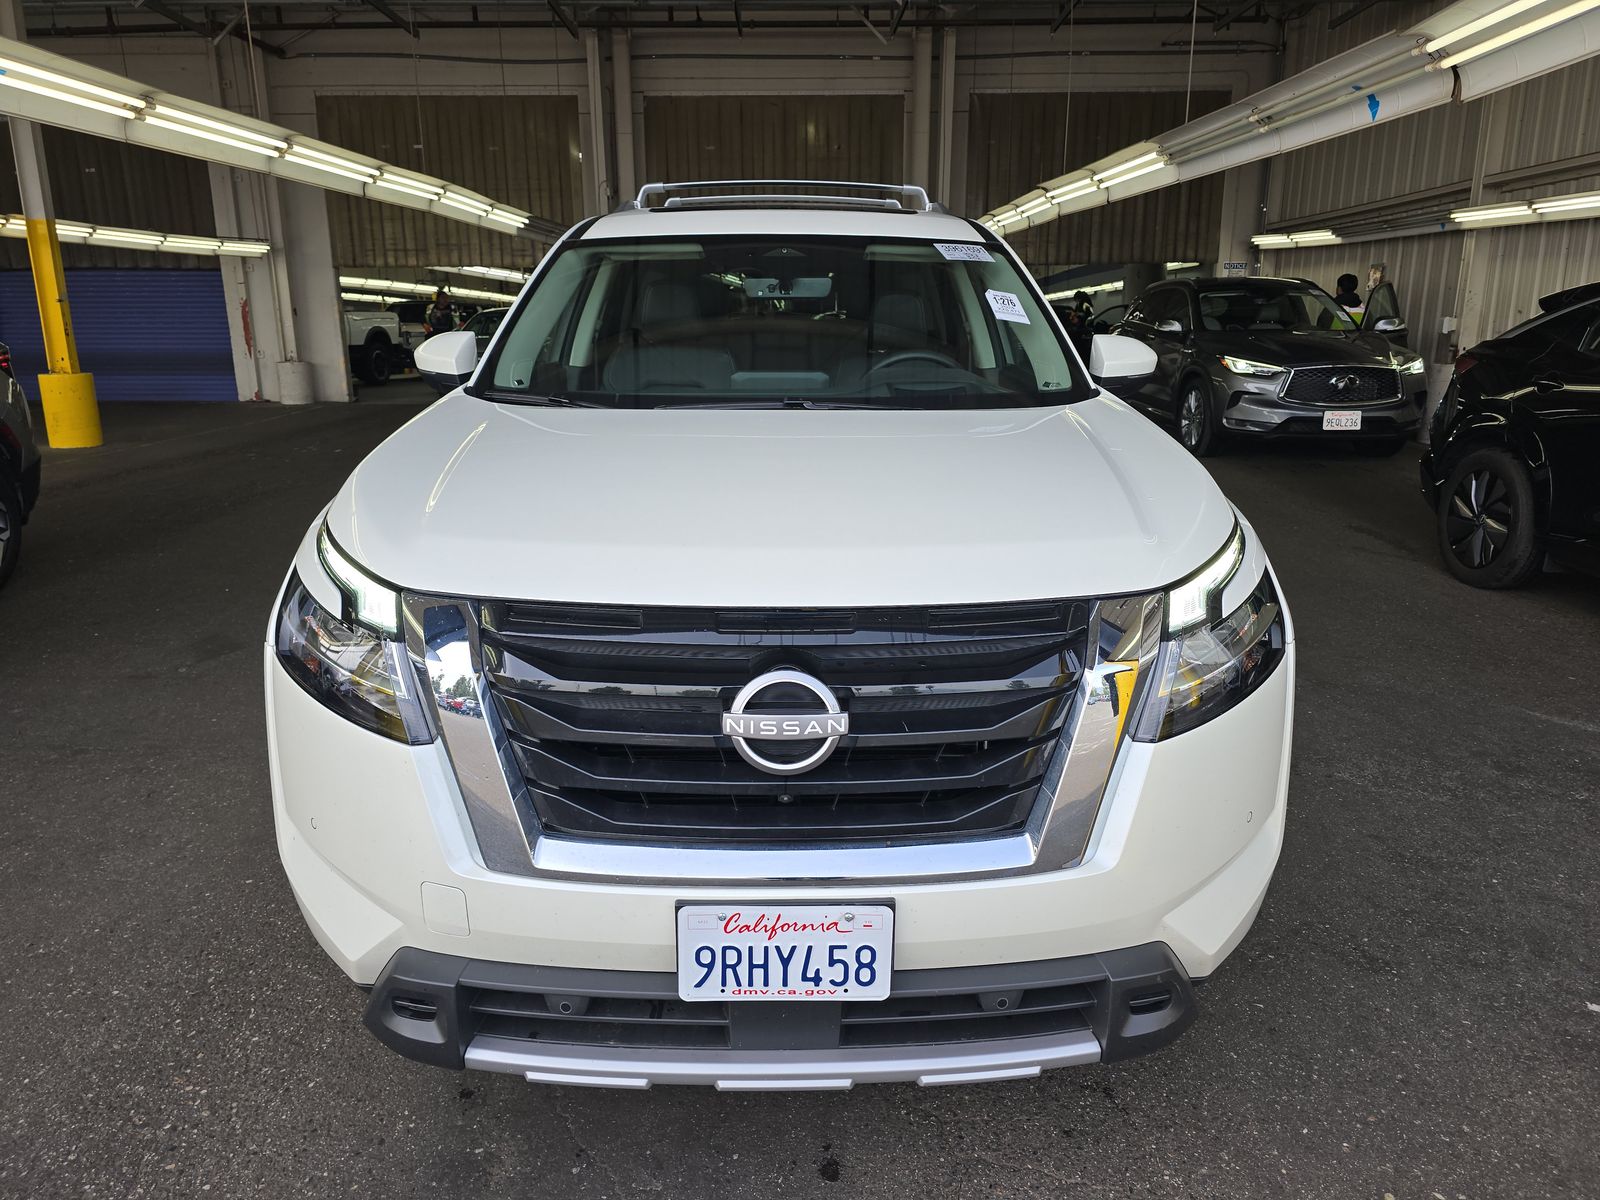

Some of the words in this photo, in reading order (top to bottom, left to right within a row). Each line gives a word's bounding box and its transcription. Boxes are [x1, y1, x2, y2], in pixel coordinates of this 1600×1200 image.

[726, 718, 845, 735] NISSAN
[723, 912, 853, 940] California
[693, 945, 877, 988] 9RHY458
[731, 988, 838, 996] dmv.ca.gov
